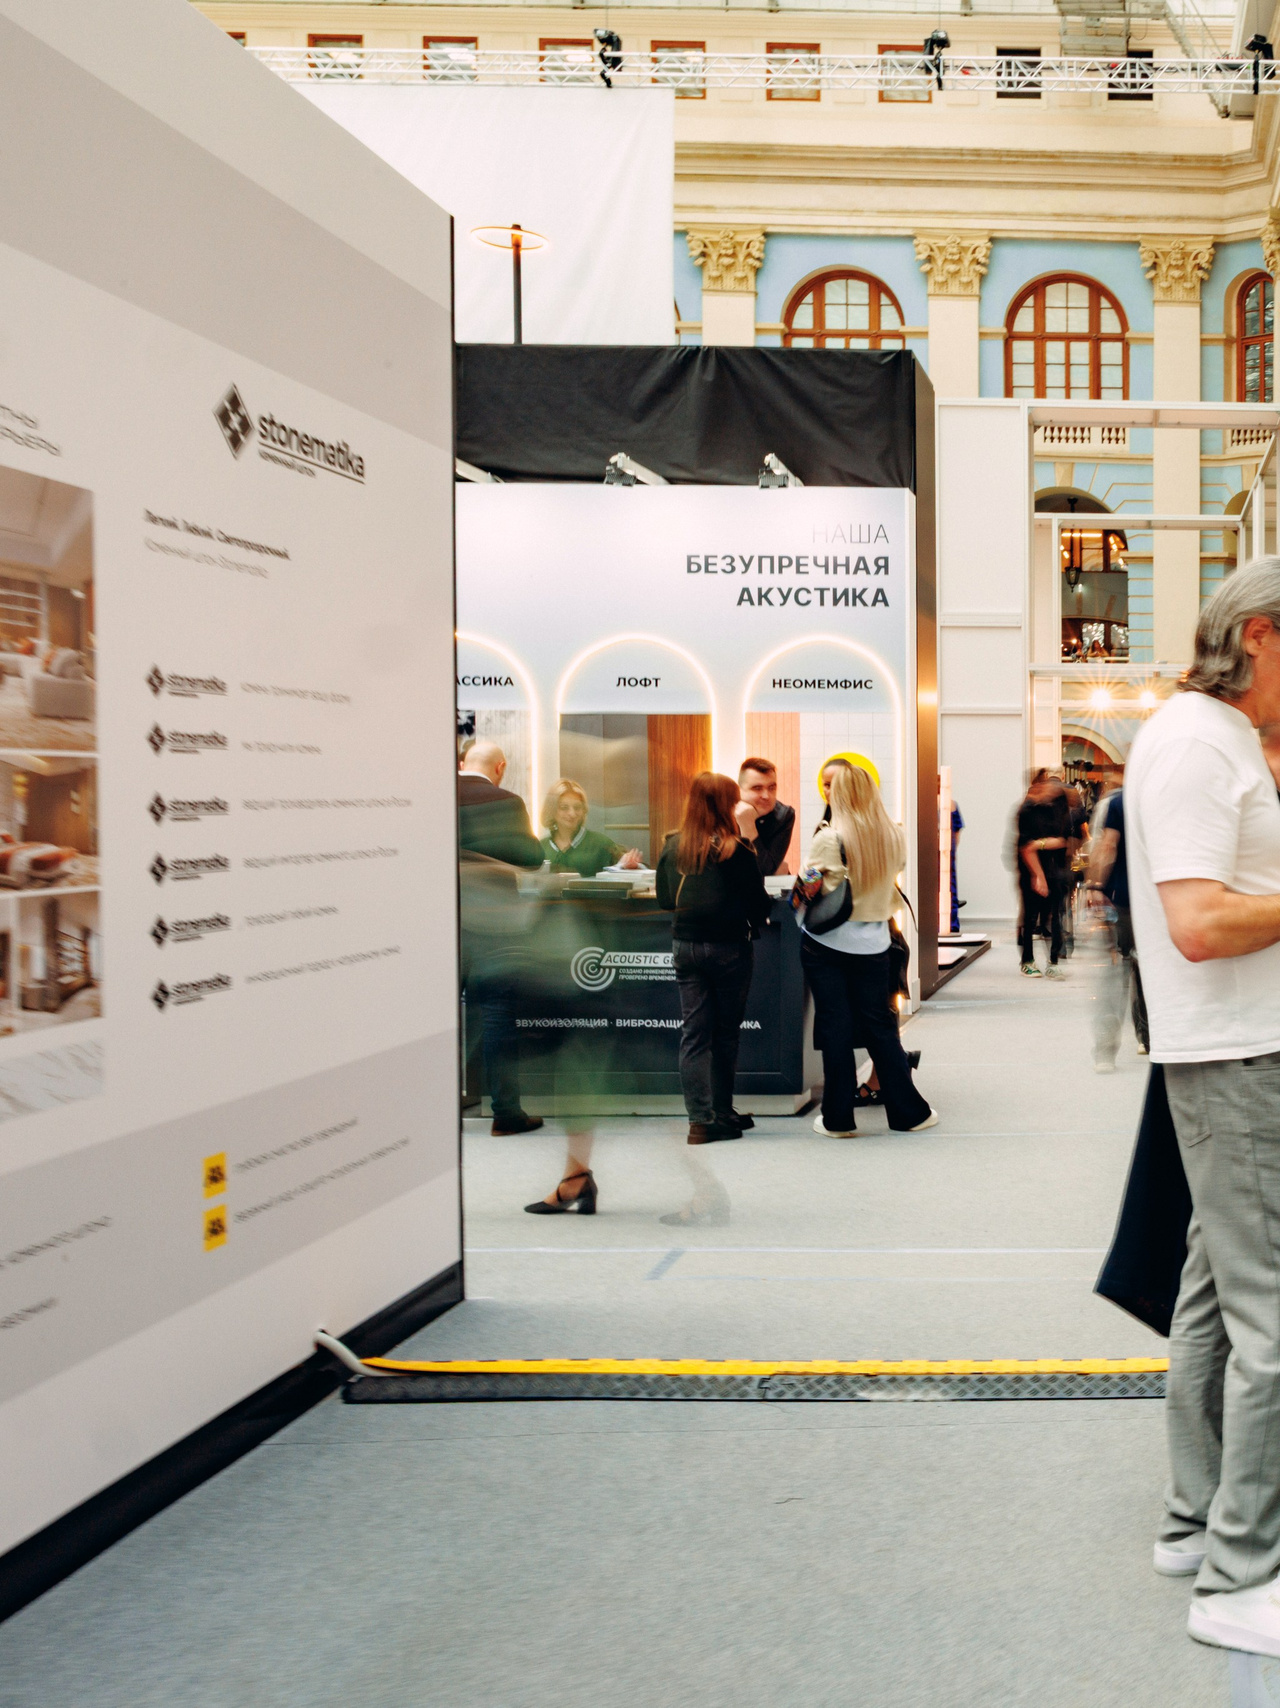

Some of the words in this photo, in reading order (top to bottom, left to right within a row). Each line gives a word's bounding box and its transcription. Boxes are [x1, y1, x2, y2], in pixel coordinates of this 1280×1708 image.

[257, 411, 366, 479] stonematika
[811, 523, 890, 544] НАША
[685, 554, 890, 576] БЕЗУПРЕЧНАЯ
[736, 586, 890, 608] АКУСТИКА
[615, 676, 662, 690] ЛОФТ
[771, 677, 874, 691] НЕОМЕМФИС
[604, 954, 660, 965] ACOUSTIC
[514, 1018, 608, 1030] ЗВУКОИЗОЛЯЦИЯ
[615, 1018, 685, 1030] ВИБРОЗАЩИ
